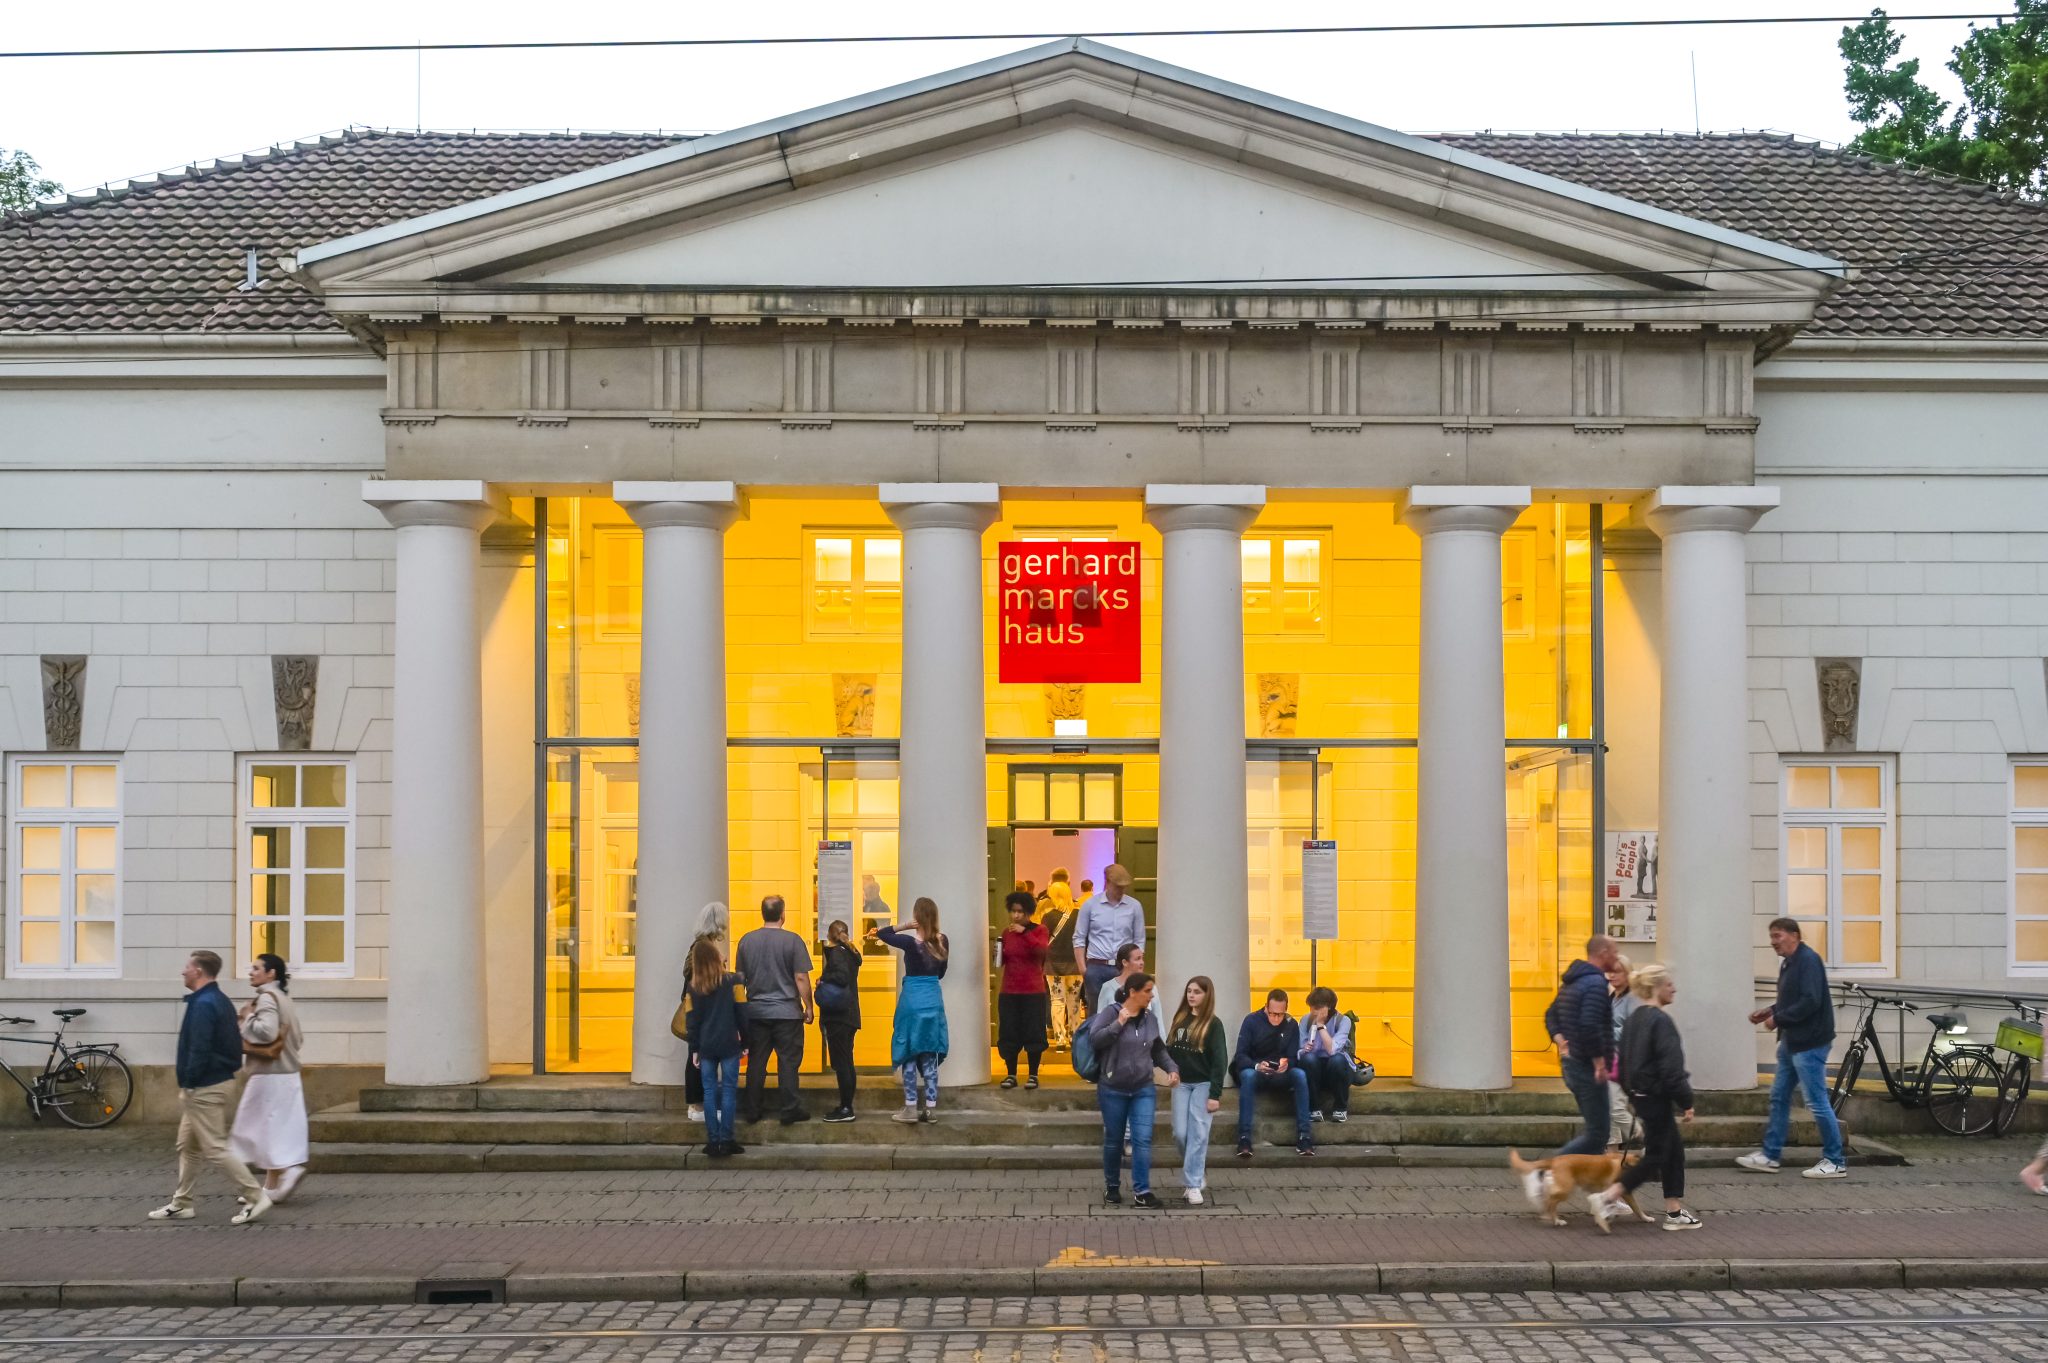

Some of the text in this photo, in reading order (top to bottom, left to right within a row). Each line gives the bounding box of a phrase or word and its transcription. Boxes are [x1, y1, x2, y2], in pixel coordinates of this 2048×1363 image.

[1004, 546, 1135, 584] gerhard
[1005, 580, 1129, 610] marcks
[1005, 615, 1084, 644] haus
[1616, 842, 1628, 878] Péri's
[1624, 840, 1637, 878] People
